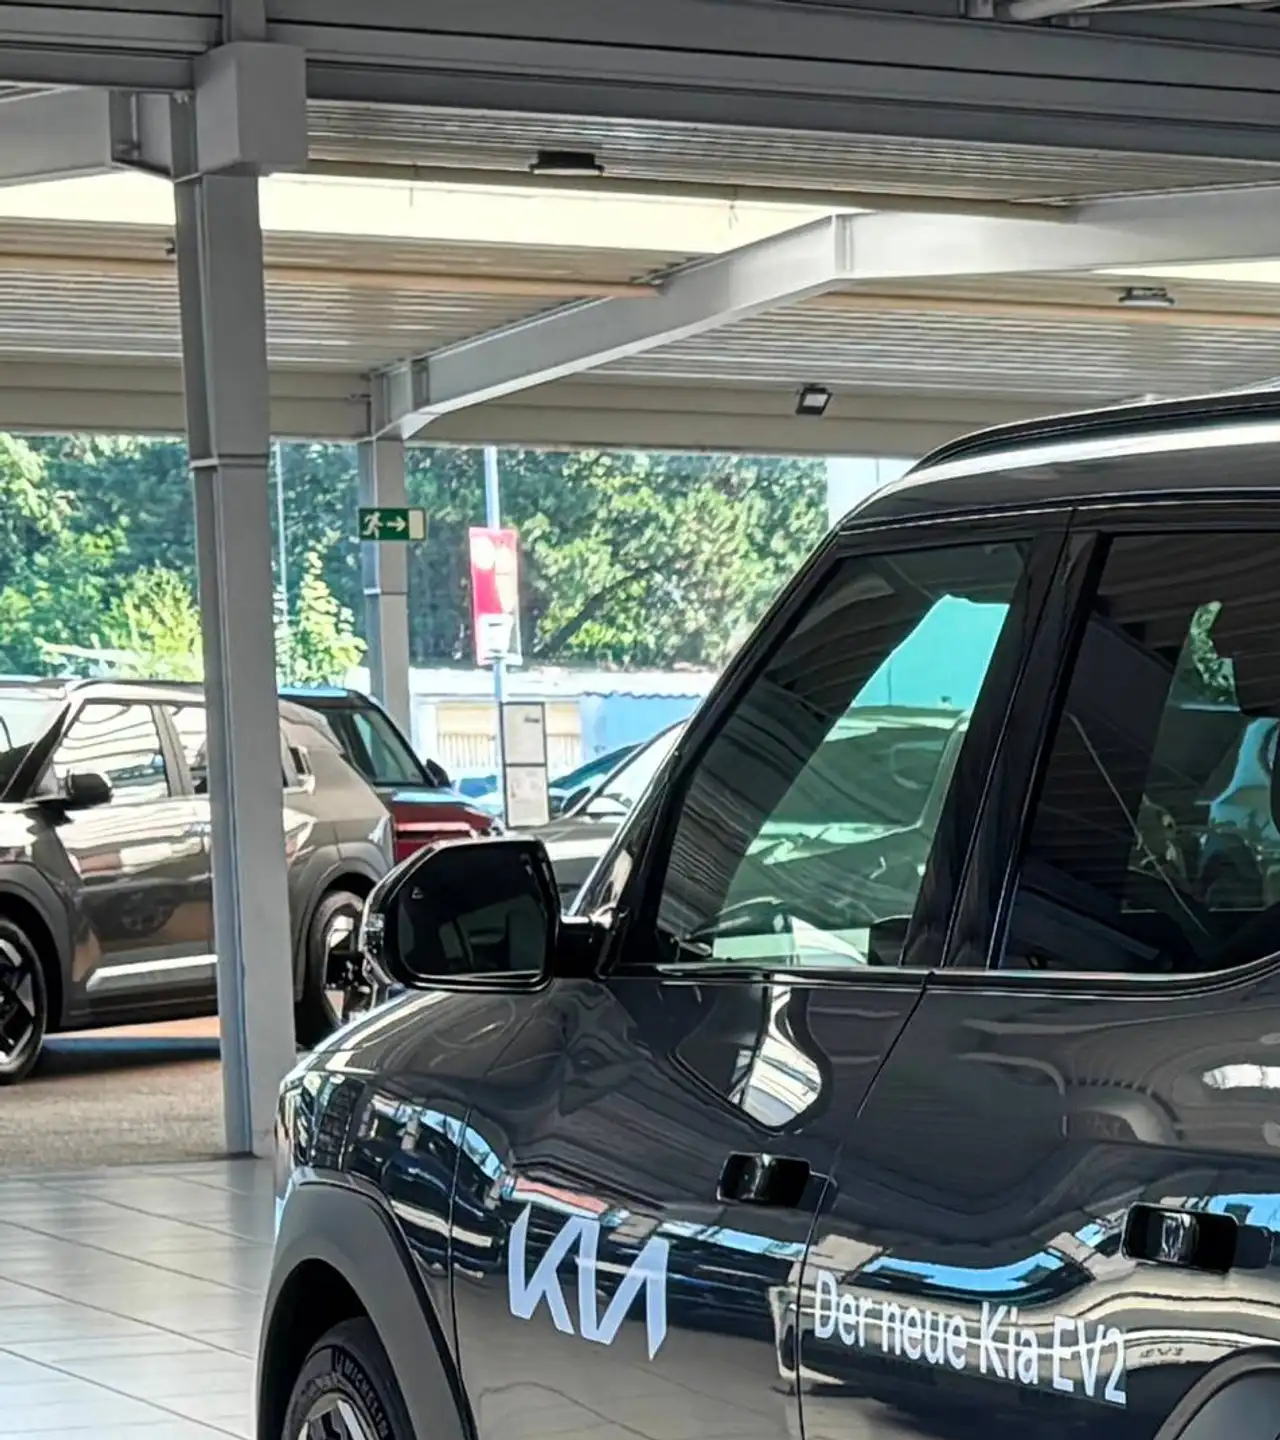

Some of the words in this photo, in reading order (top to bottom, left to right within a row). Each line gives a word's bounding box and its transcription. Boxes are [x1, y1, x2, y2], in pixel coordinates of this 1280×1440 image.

[509, 1201, 669, 1361] KIA
[814, 1269, 873, 1348] Der
[881, 1301, 968, 1370] neue
[979, 1301, 1038, 1384] Kia
[1053, 1314, 1127, 1404] EV2
